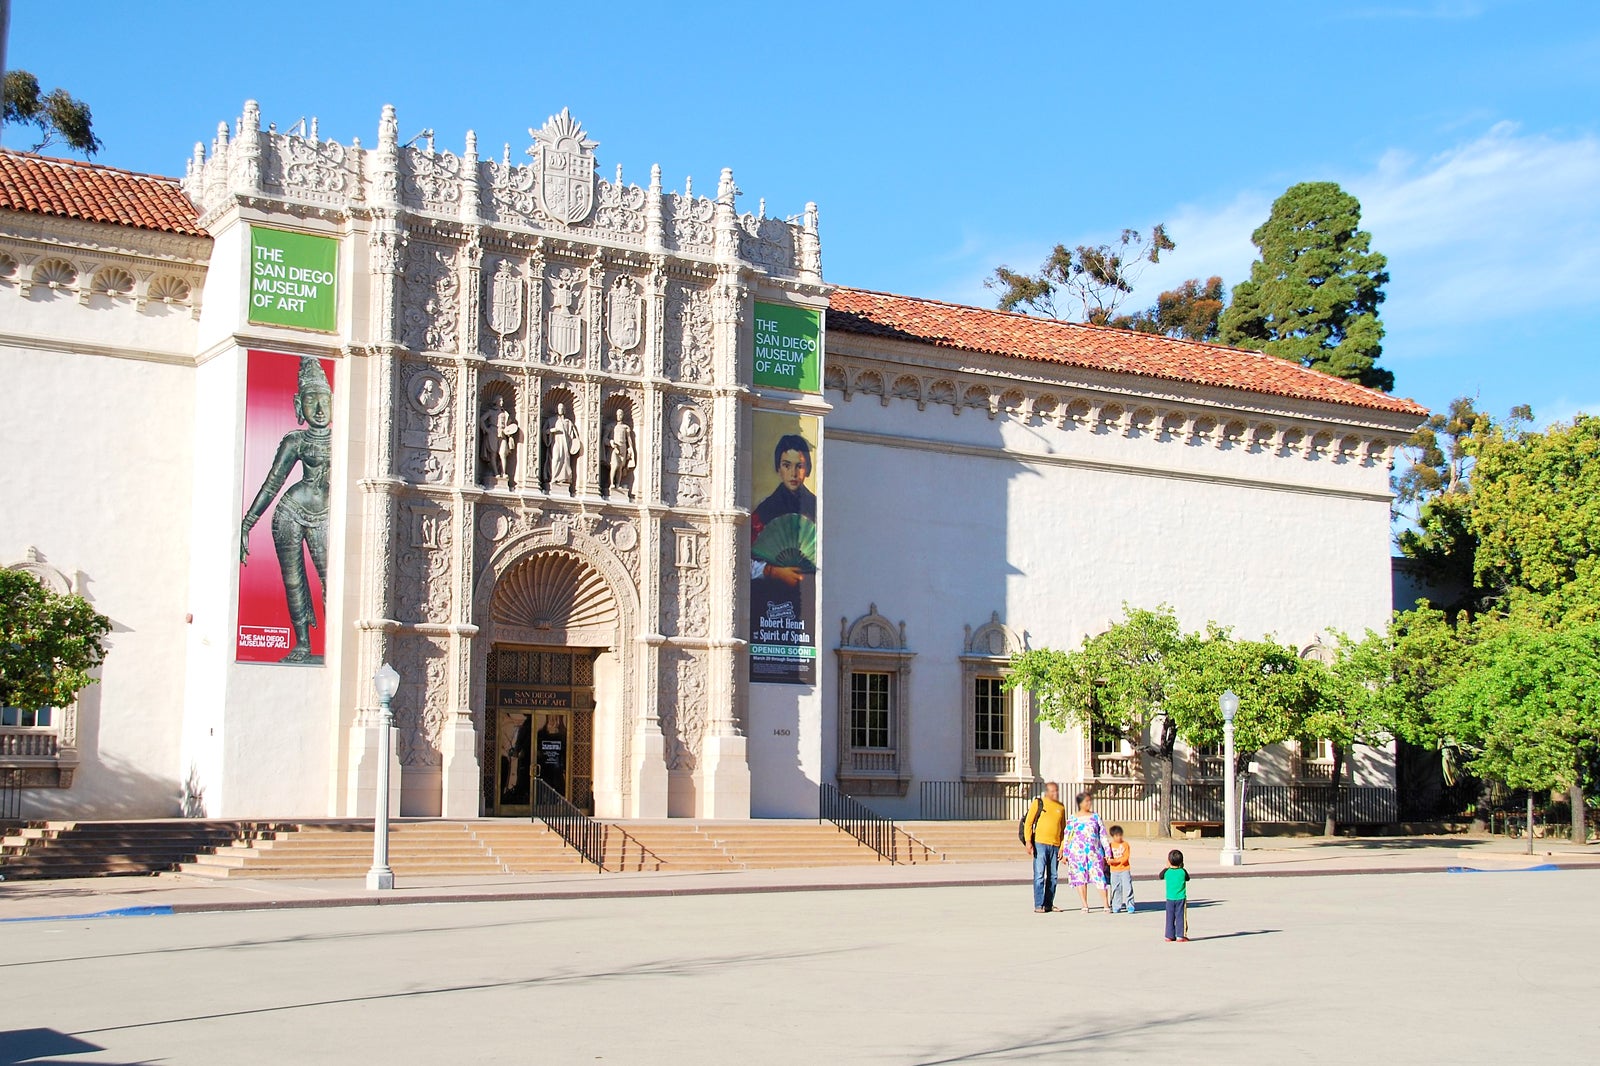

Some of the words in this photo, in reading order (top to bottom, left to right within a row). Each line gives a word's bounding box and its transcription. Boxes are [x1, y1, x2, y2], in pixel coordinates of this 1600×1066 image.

[255, 245, 284, 263] THE
[254, 262, 286, 279] SAN
[289, 267, 334, 285] DIEGO
[254, 278, 317, 299] MUSEUM
[253, 293, 274, 308] OF
[276, 297, 307, 313] ART
[755, 318, 778, 333] THE
[756, 332, 780, 347] SAN
[782, 336, 816, 352] DIEGO
[756, 346, 804, 363] MUSEUM
[755, 360, 771, 372] OF
[773, 363, 796, 376] ART
[760, 616, 784, 628] Robert
[785, 618, 805, 630] Henri
[239, 640, 266, 648] MUSEUM
[760, 629, 780, 642] Spirit
[781, 630, 789, 641] of
[790, 631, 810, 644] Spain
[752, 646, 786, 655] OPENING
[787, 647, 811, 656] SOON!
[514, 690, 530, 698] SAN
[538, 698, 548, 706] OF
